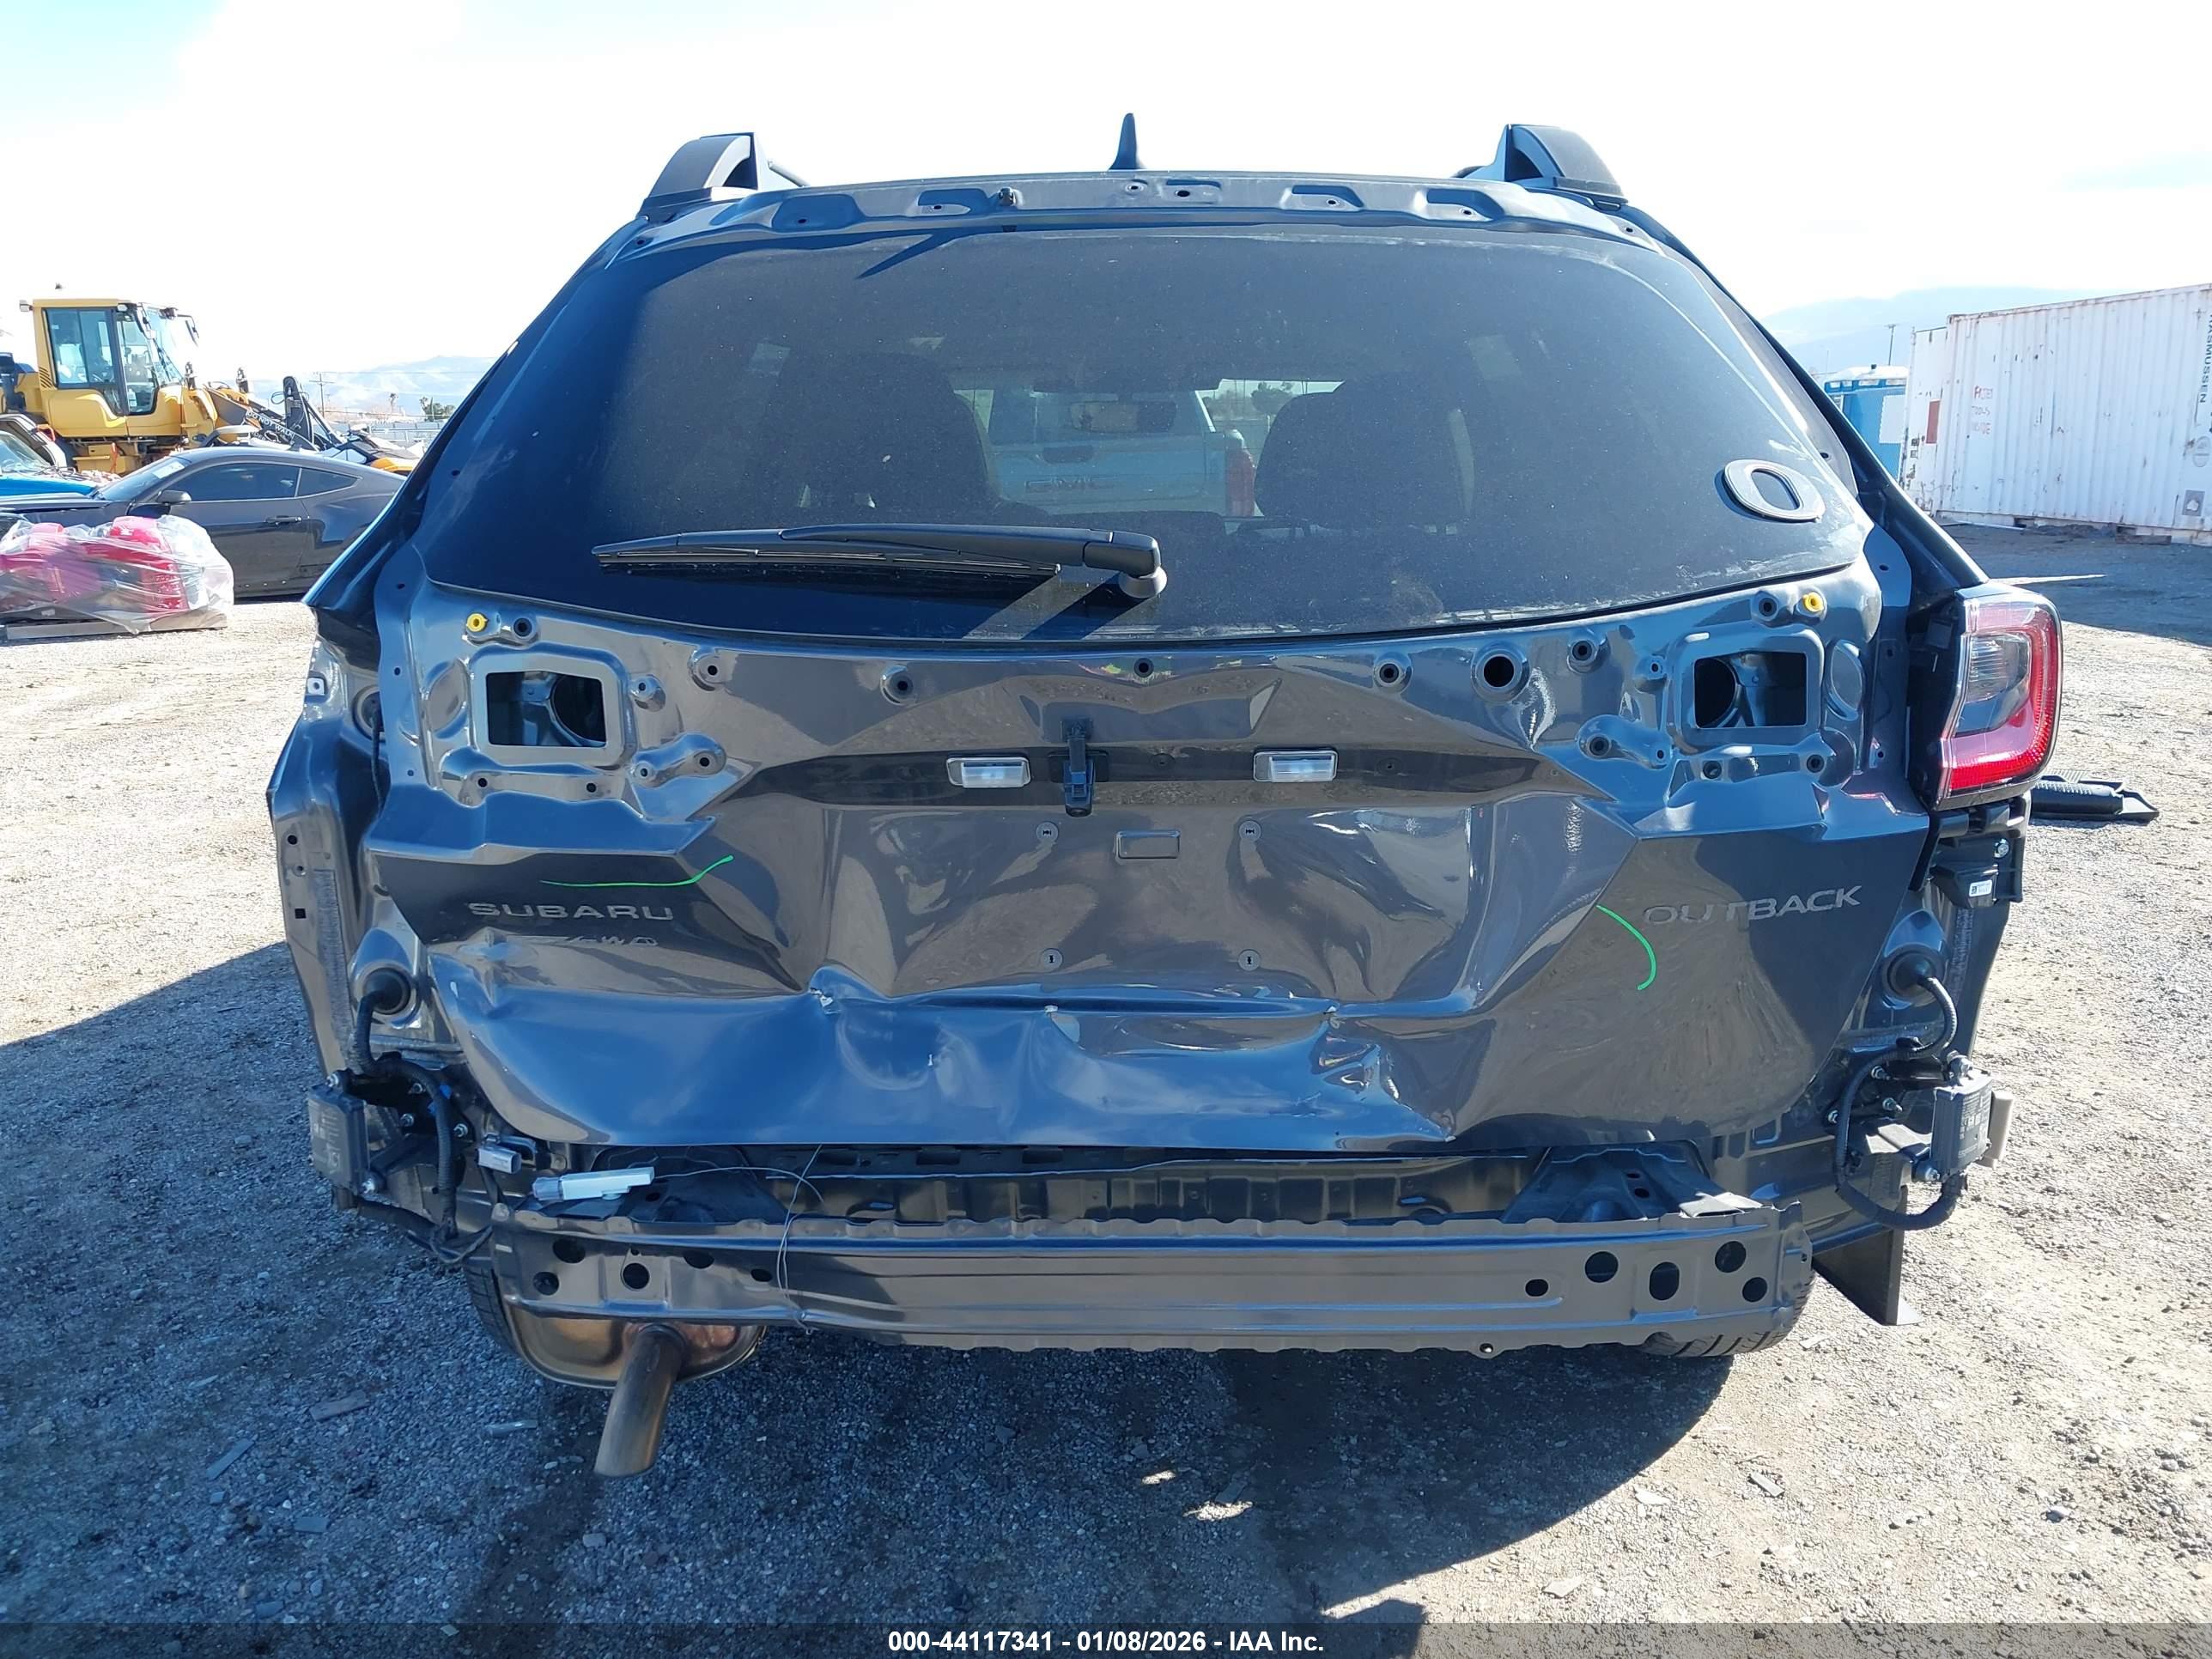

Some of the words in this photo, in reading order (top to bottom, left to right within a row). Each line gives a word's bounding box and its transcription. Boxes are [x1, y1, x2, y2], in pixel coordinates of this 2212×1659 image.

[259, 416, 274, 428] NOT
[275, 424, 294, 437] WALK
[468, 902, 674, 921] SUBARU
[1643, 885, 1863, 927] OUTBACK
